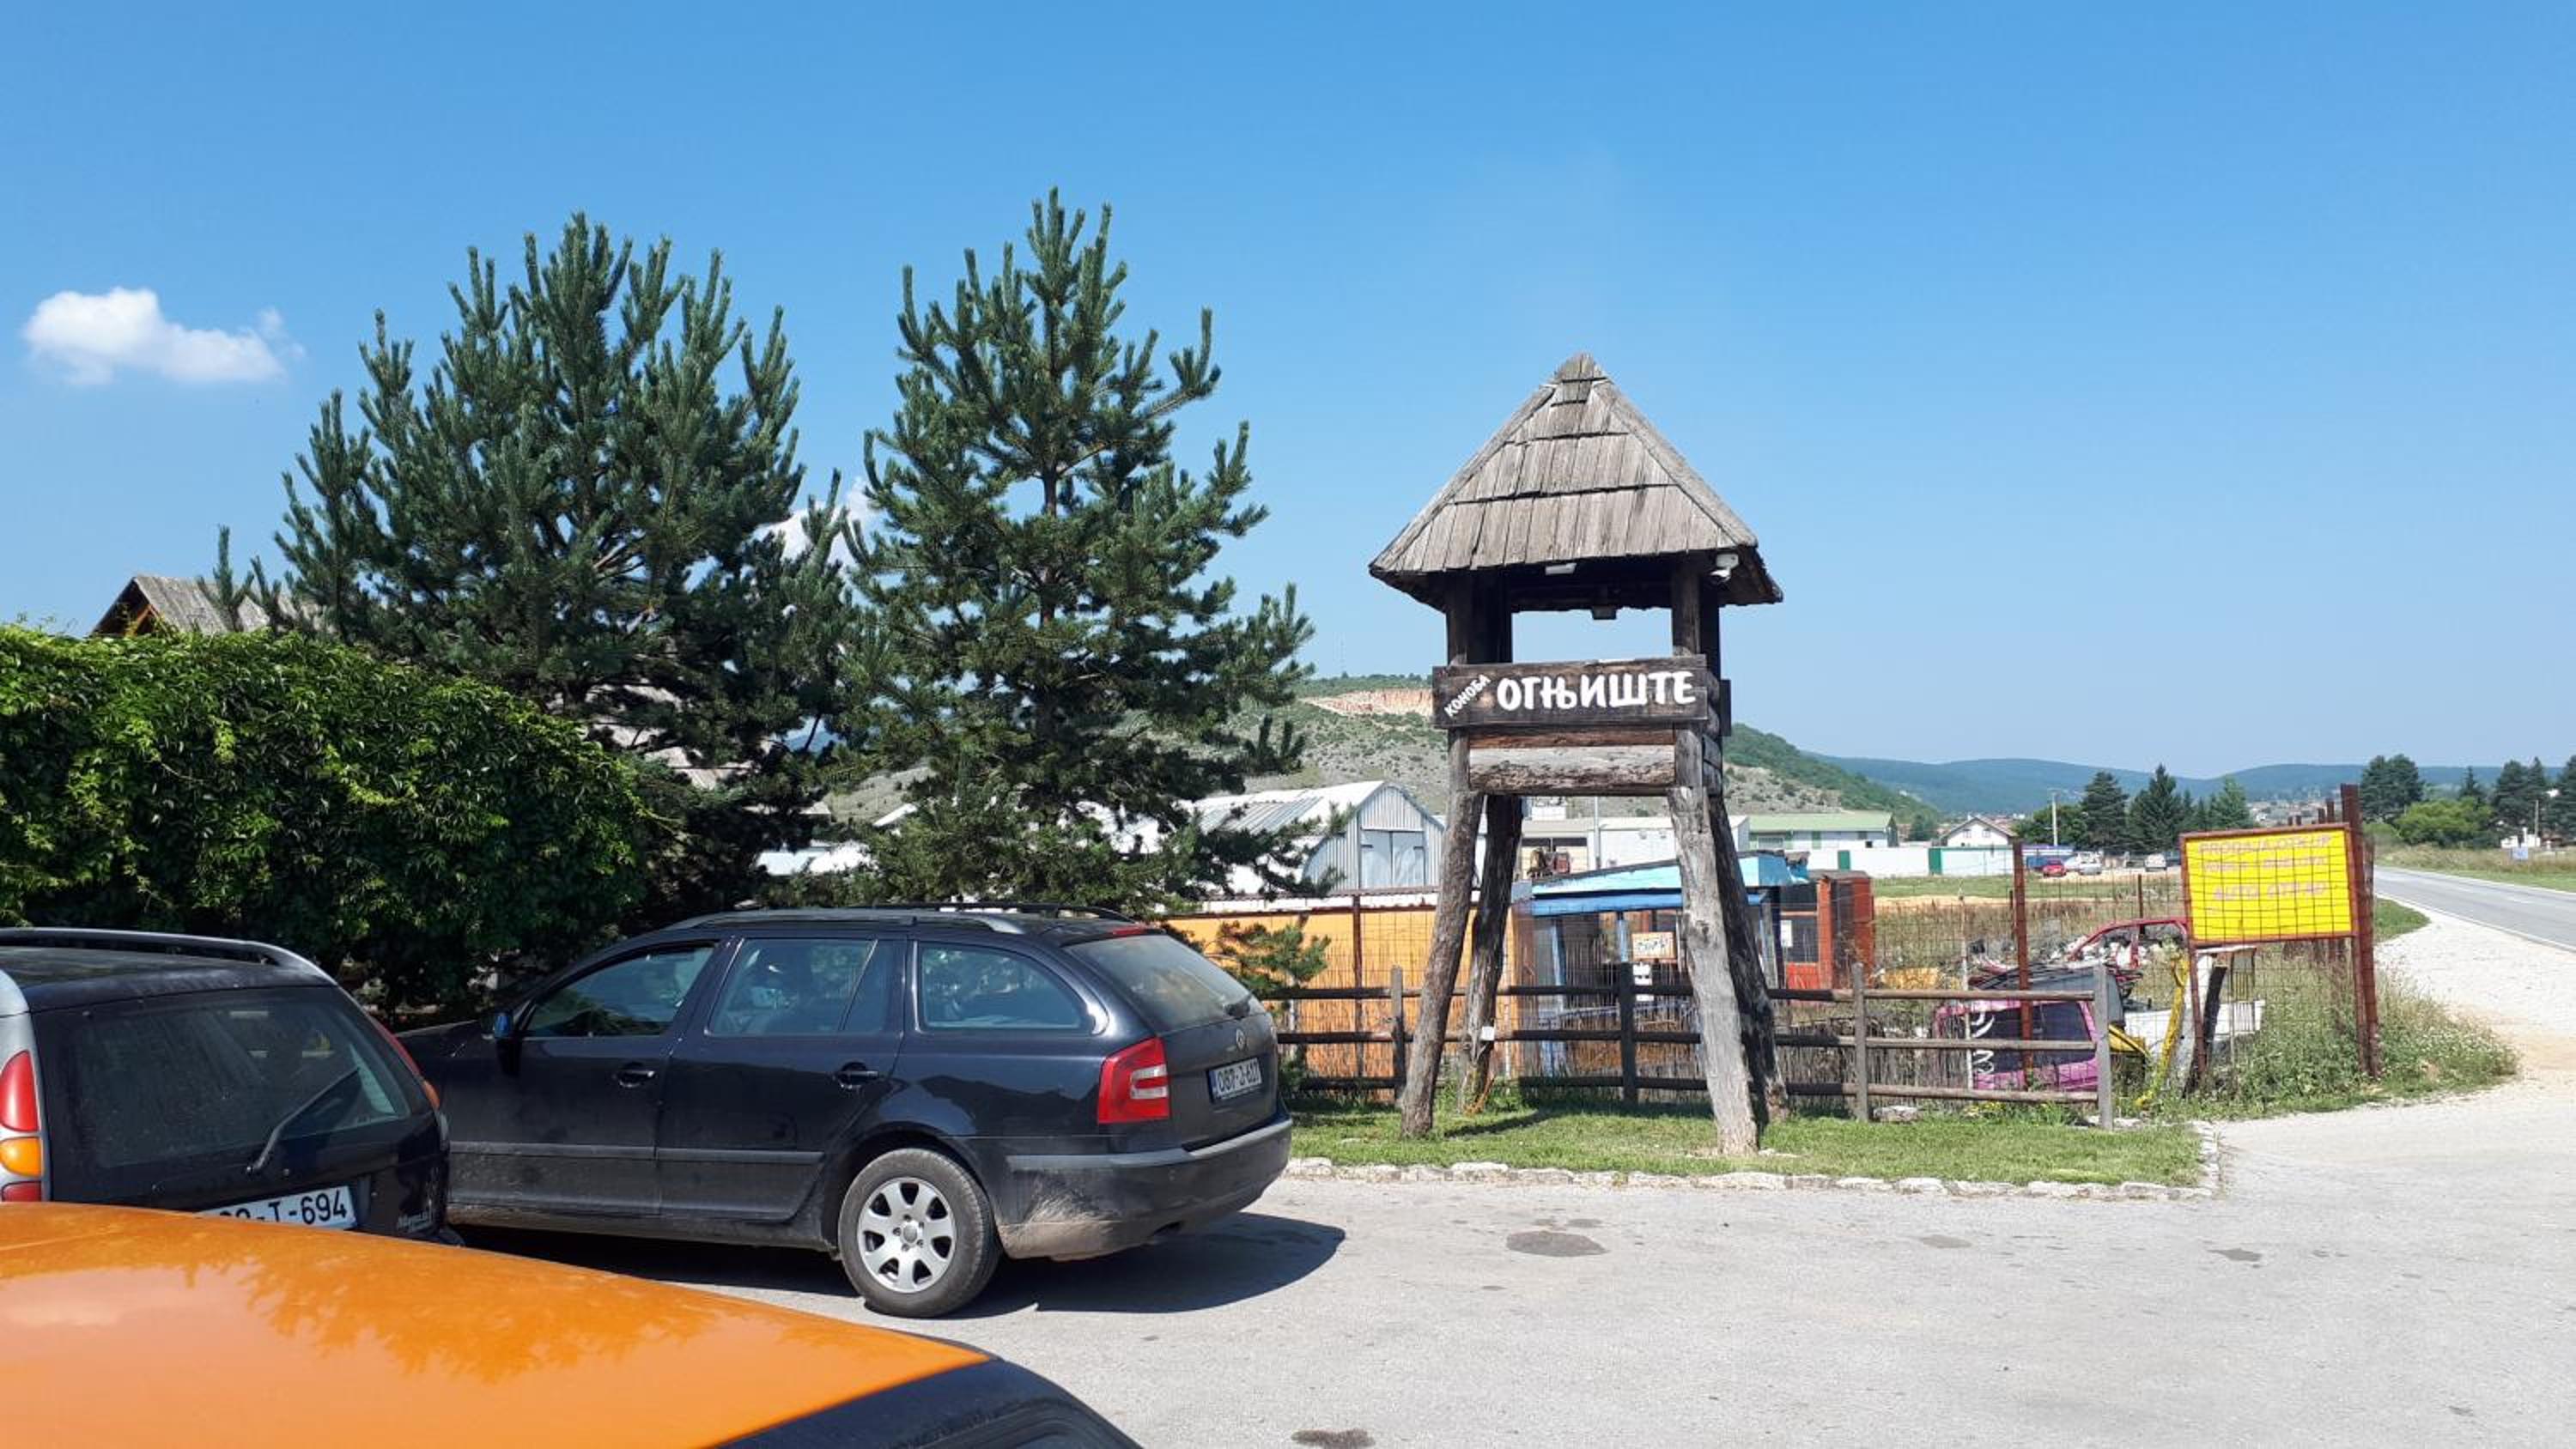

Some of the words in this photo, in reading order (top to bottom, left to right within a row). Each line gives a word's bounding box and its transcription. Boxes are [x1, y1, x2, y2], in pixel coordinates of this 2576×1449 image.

[1443, 674, 1491, 718] КОНОБА
[1497, 671, 1696, 711] ОГЊИШТЕ
[219, 1190, 346, 1224] -T-694
